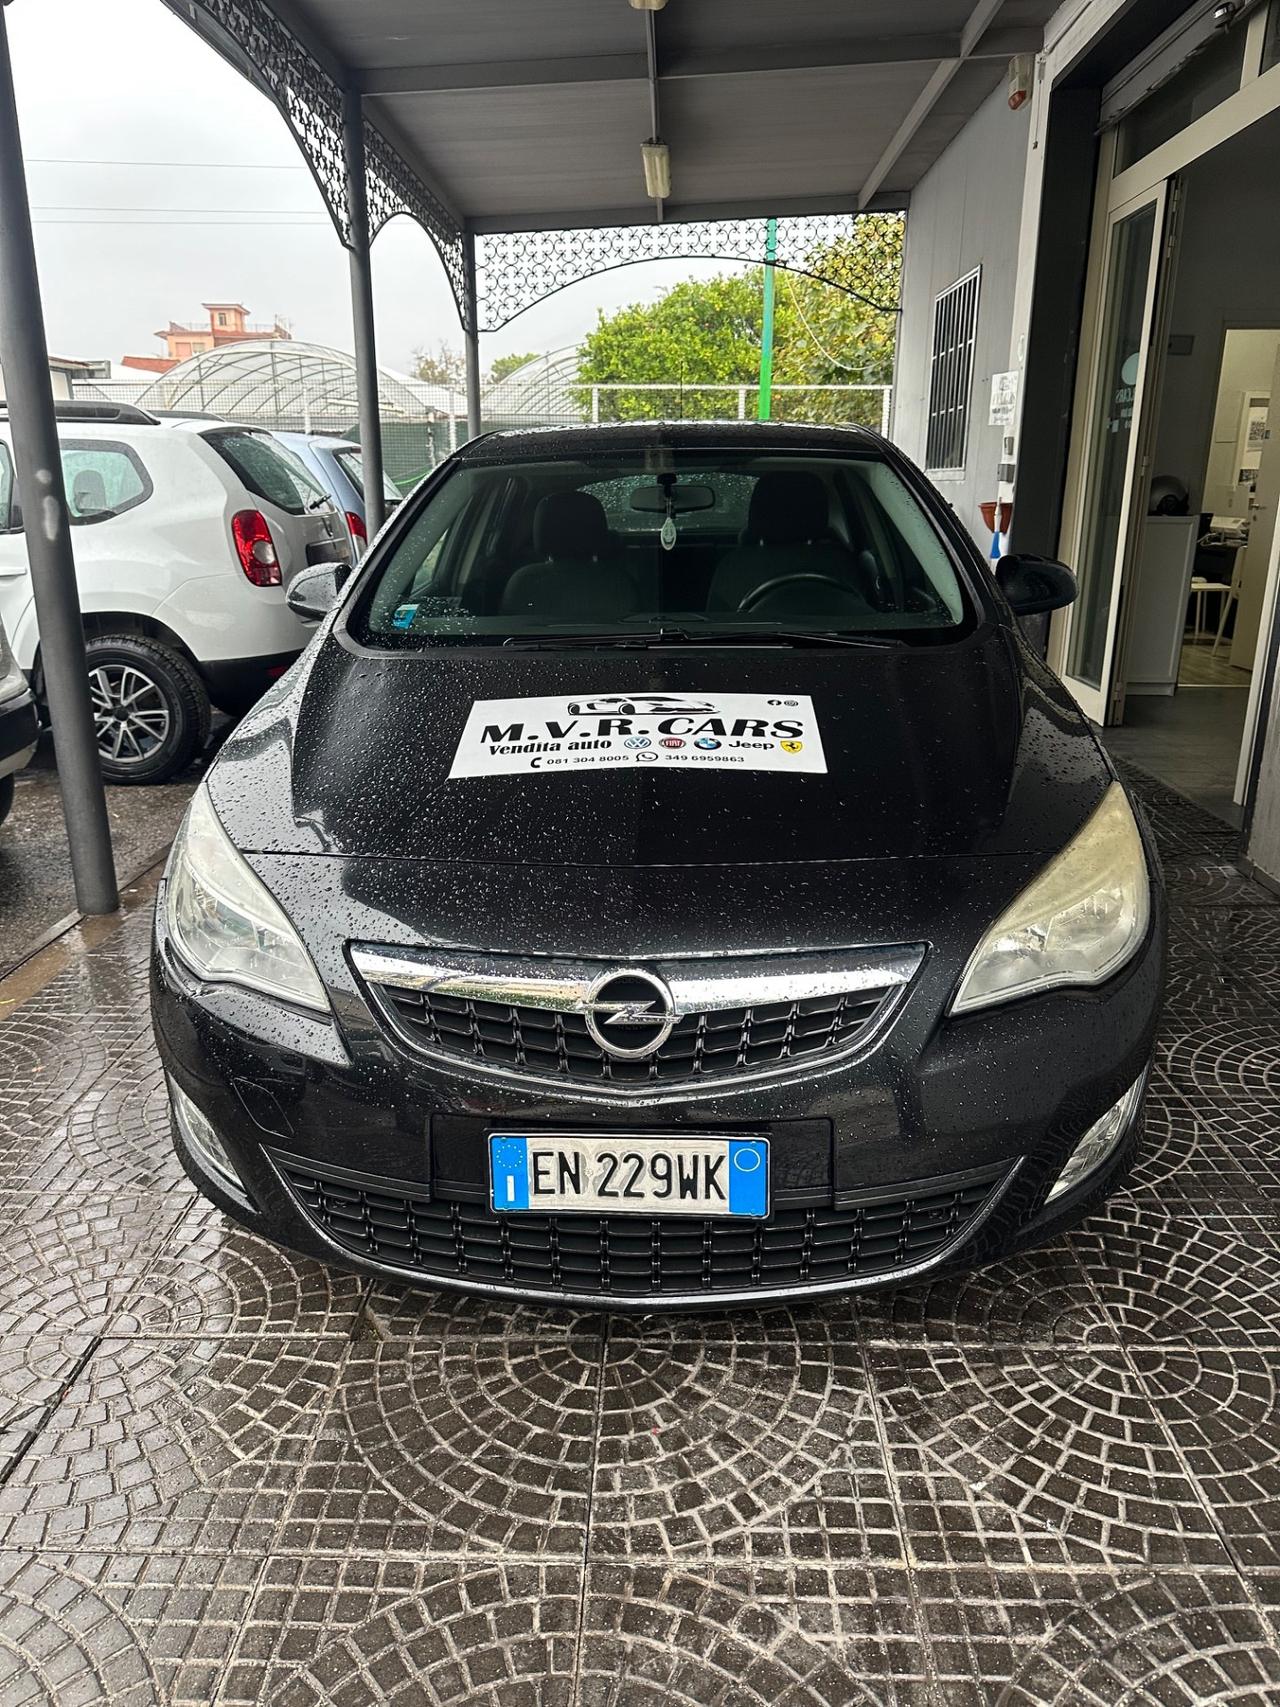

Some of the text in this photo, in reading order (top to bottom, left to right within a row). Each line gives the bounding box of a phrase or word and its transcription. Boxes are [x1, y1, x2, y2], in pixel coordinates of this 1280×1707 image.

[567, 739, 612, 751] auto
[728, 740, 775, 750] Jeep
[599, 755, 630, 763] 8005
[691, 755, 745, 763] 6959863
[532, 1151, 727, 1201] EN 229WK
